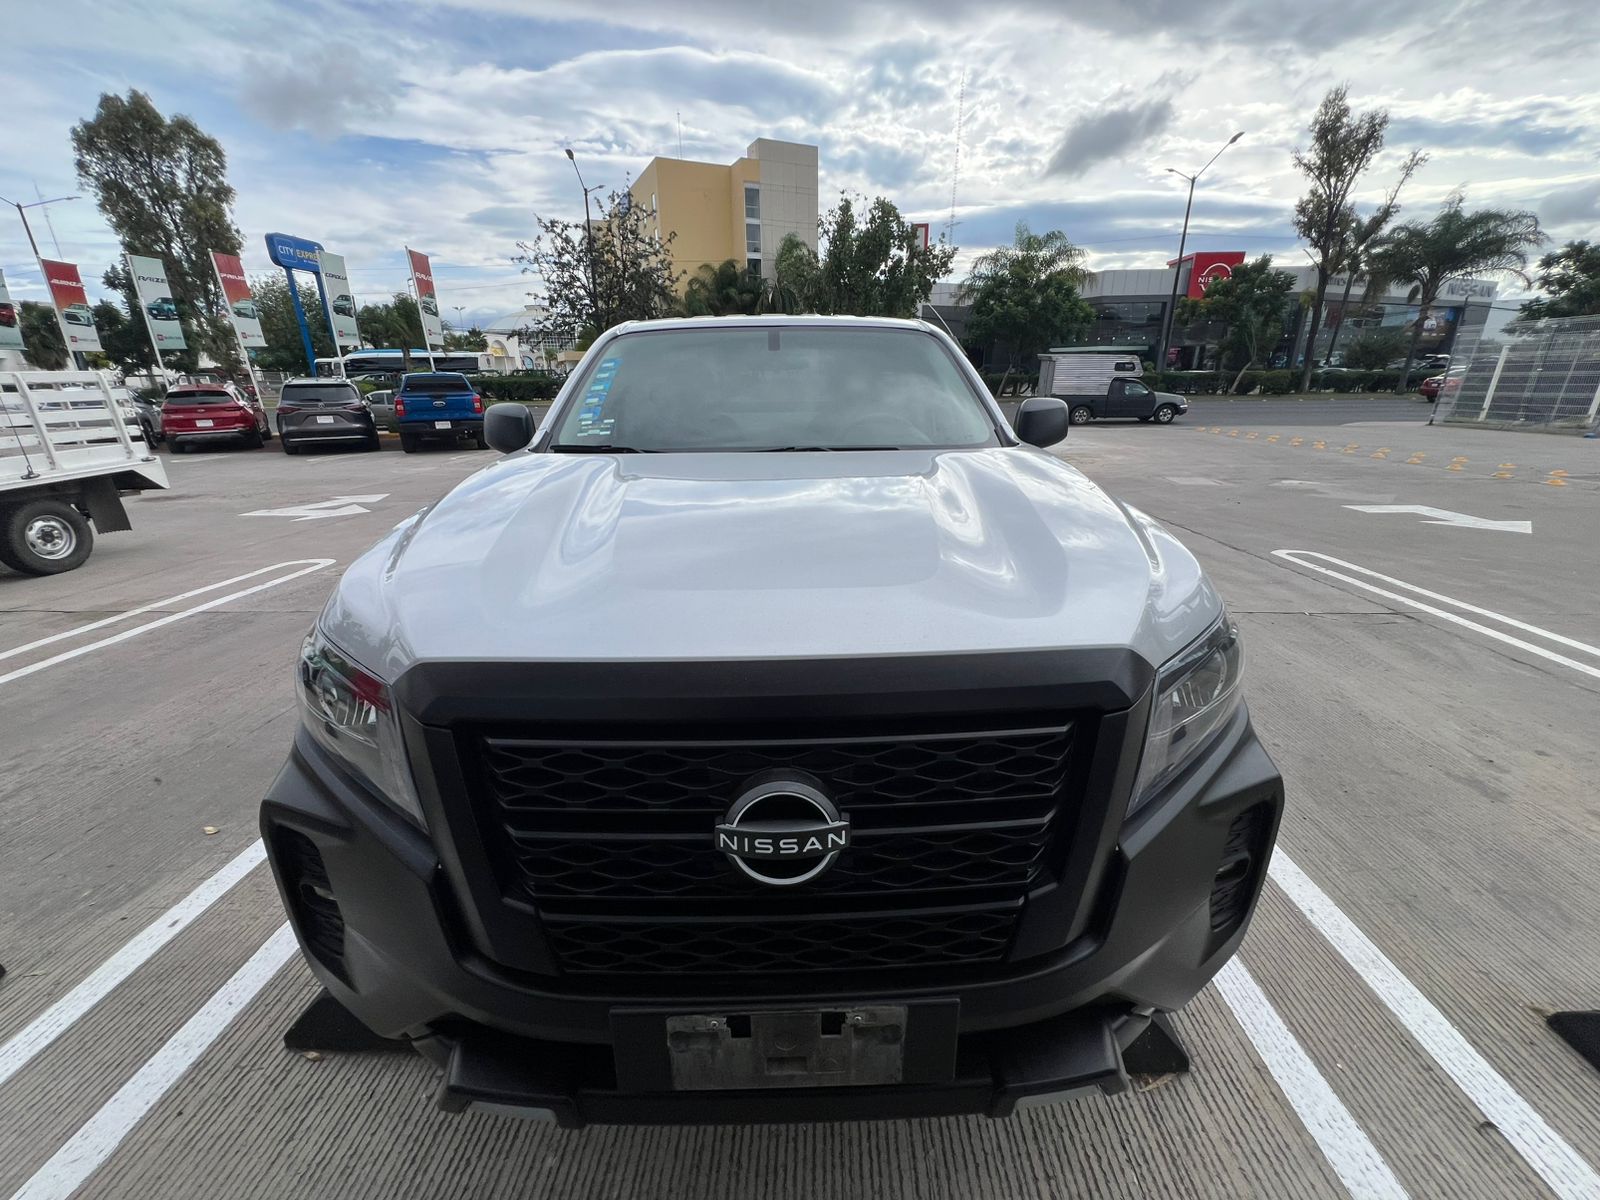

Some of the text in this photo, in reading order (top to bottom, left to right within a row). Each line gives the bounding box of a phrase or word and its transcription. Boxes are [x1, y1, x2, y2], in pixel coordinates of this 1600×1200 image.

[278, 245, 294, 256] CITY
[137, 275, 168, 284] RAIZE
[719, 830, 846, 854] NISSAN
